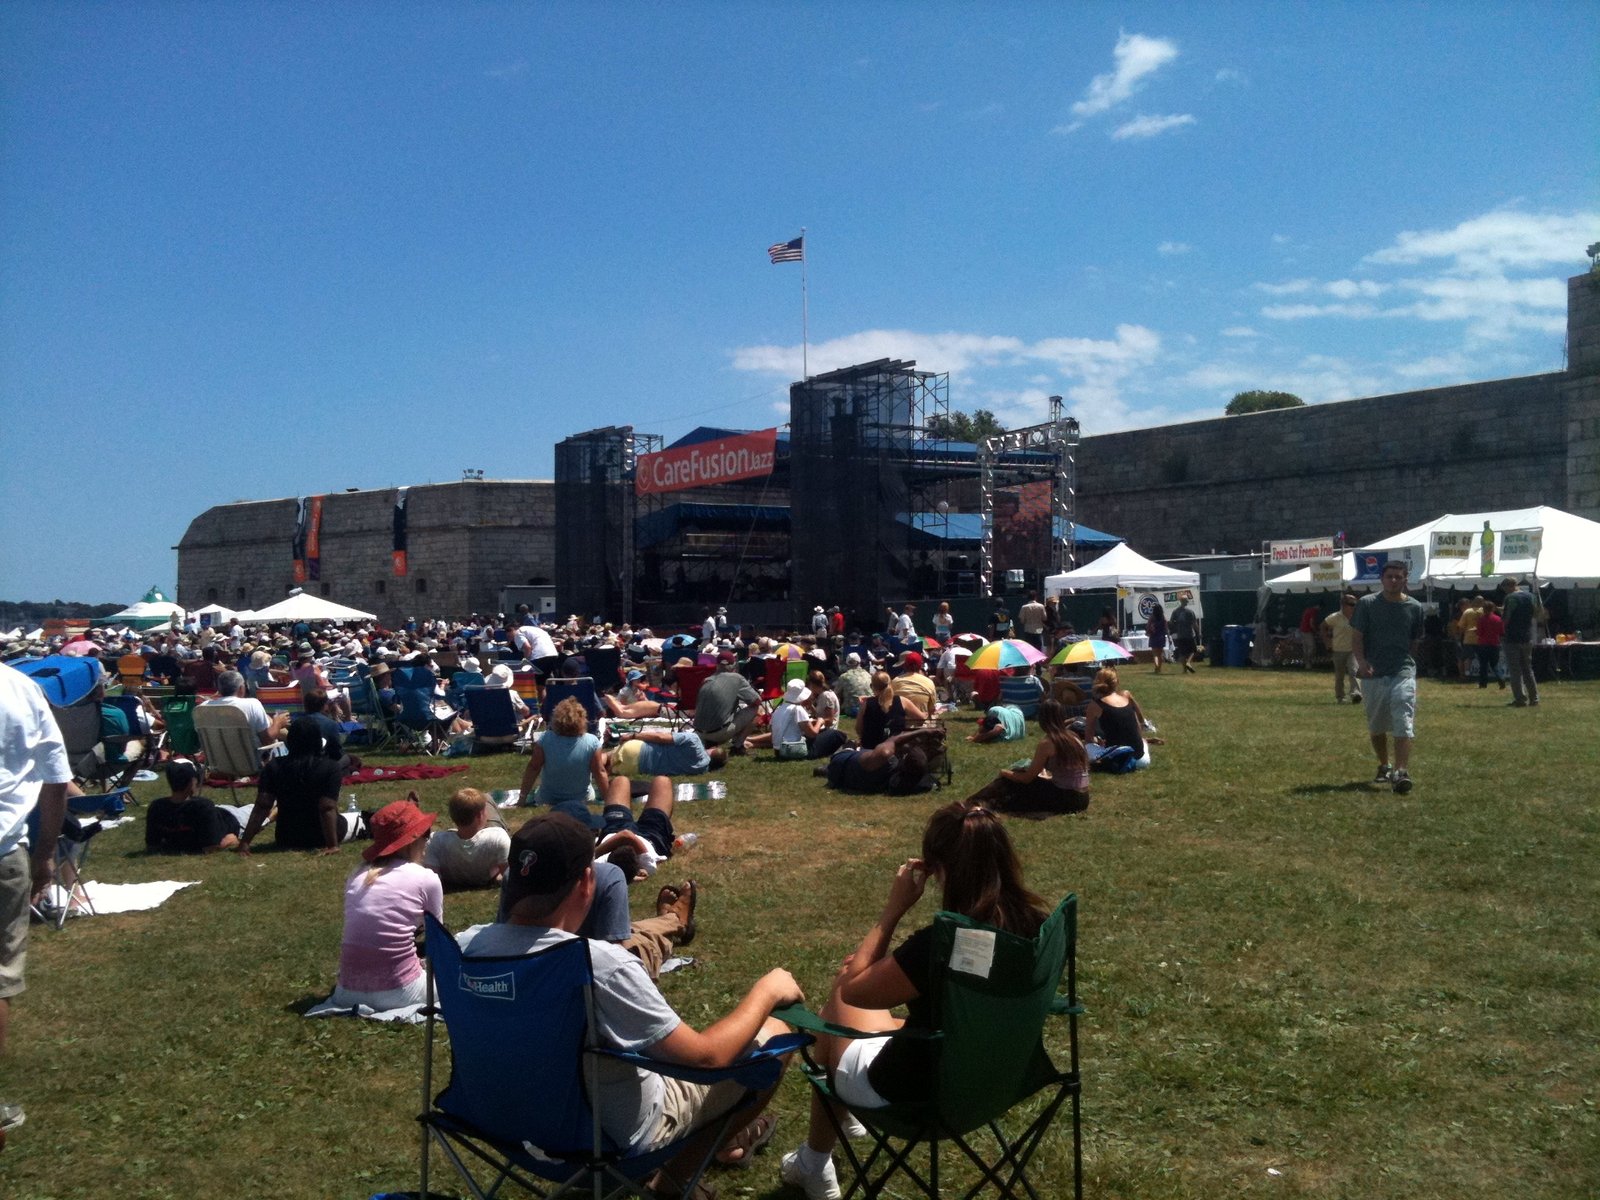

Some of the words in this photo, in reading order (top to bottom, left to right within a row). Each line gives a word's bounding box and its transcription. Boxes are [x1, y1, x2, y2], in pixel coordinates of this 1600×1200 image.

[653, 443, 749, 487] CareFusion
[750, 452, 773, 470] Jazz
[1272, 547, 1288, 560] Fresh
[1289, 546, 1298, 559] Cut
[1299, 544, 1319, 559] French
[1320, 543, 1333, 557] Fries
